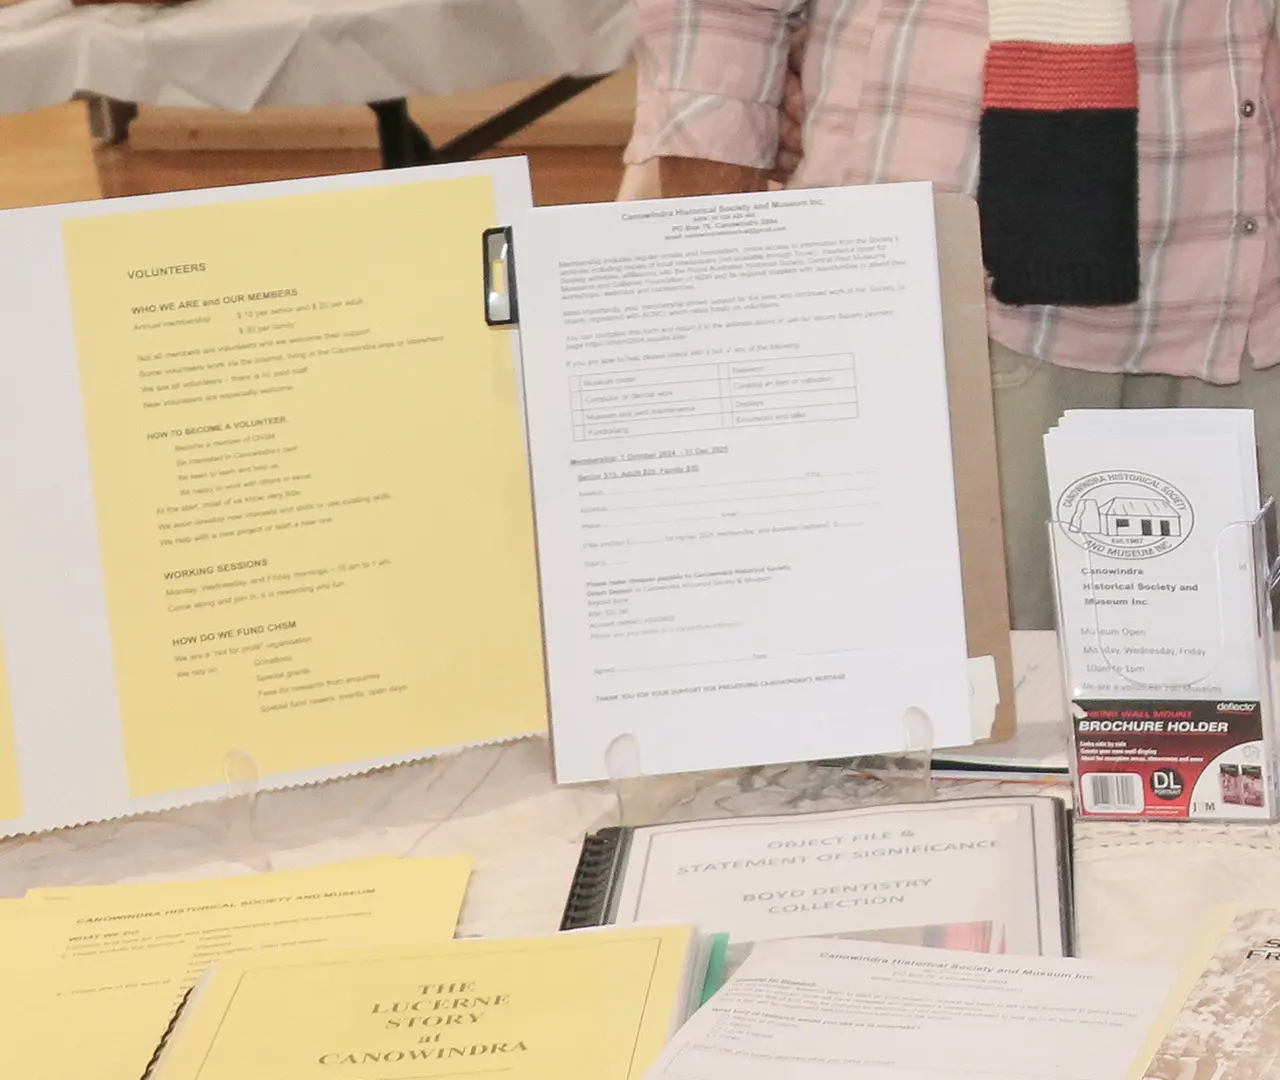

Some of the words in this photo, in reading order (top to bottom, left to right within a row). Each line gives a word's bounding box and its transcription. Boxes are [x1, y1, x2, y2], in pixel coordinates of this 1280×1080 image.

[127, 262, 207, 280] VOLUNTEERS
[131, 304, 156, 314] WHO
[159, 302, 176, 312] WE
[178, 300, 200, 310] ARE
[203, 297, 220, 307] and
[223, 294, 245, 305] OUR
[247, 288, 298, 302] MEMBERS
[163, 565, 215, 580] WORKING
[216, 558, 268, 572] SESSIONS
[1081, 567, 1144, 575] Canowindra
[1138, 582, 1176, 592] Society
[1078, 721, 1164, 732] BROCHURE
[1167, 721, 1229, 733] HOLDER
[1153, 771, 1181, 789] DL
[743, 888, 806, 903] BOYD
[812, 877, 933, 897] DENTISTRY
[767, 894, 905, 914] COLLECTION
[418, 981, 476, 995] THE
[371, 994, 512, 1014] LUCERNE
[385, 1012, 486, 1029] STORY
[418, 1032, 441, 1044] at
[318, 1041, 528, 1065] CANOWINDRA
